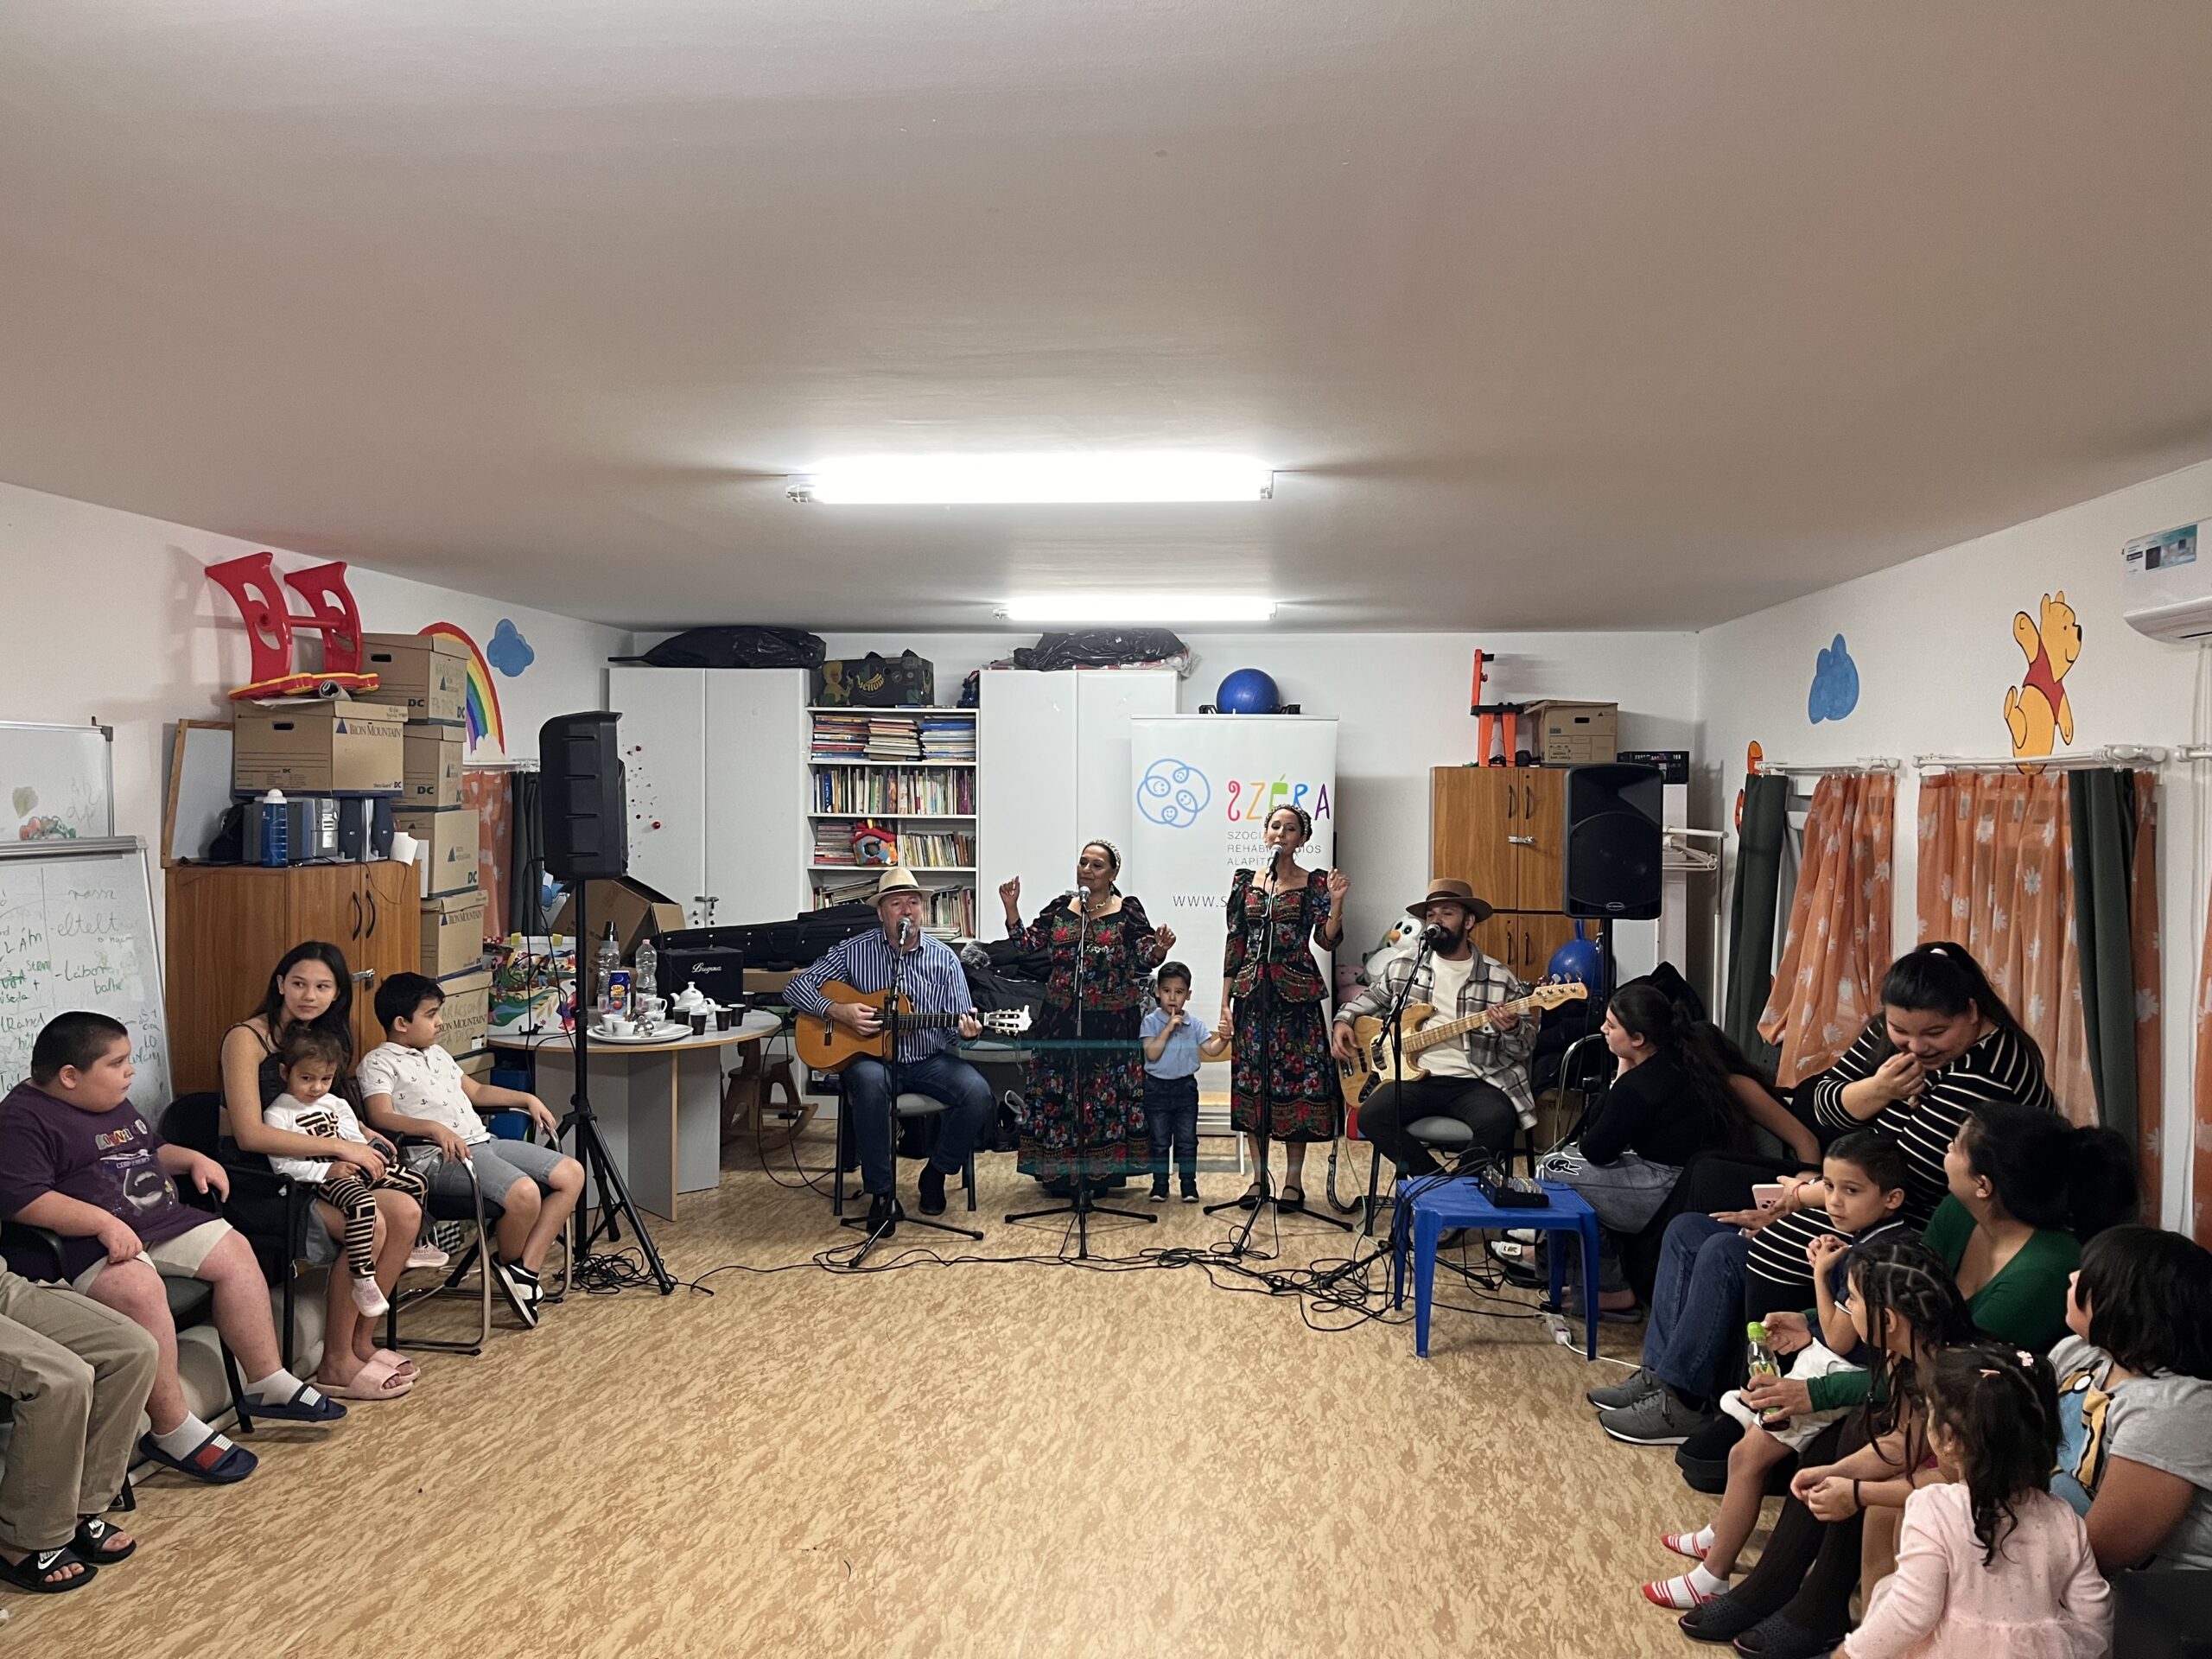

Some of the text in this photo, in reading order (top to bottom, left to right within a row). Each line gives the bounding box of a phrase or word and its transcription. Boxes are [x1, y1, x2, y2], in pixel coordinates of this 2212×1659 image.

[408, 698, 424, 707] DC
[457, 706, 465, 719] DC
[349, 724, 366, 735] IRON
[1228, 773, 1330, 822] SZÉRA
[1228, 831, 1265, 840] SZOCI
[1227, 856, 1268, 866] ALAPÍT
[467, 870, 477, 884] DC
[1173, 895, 1228, 907] WWW.S
[453, 1015, 486, 1029] MOUNTAIN
